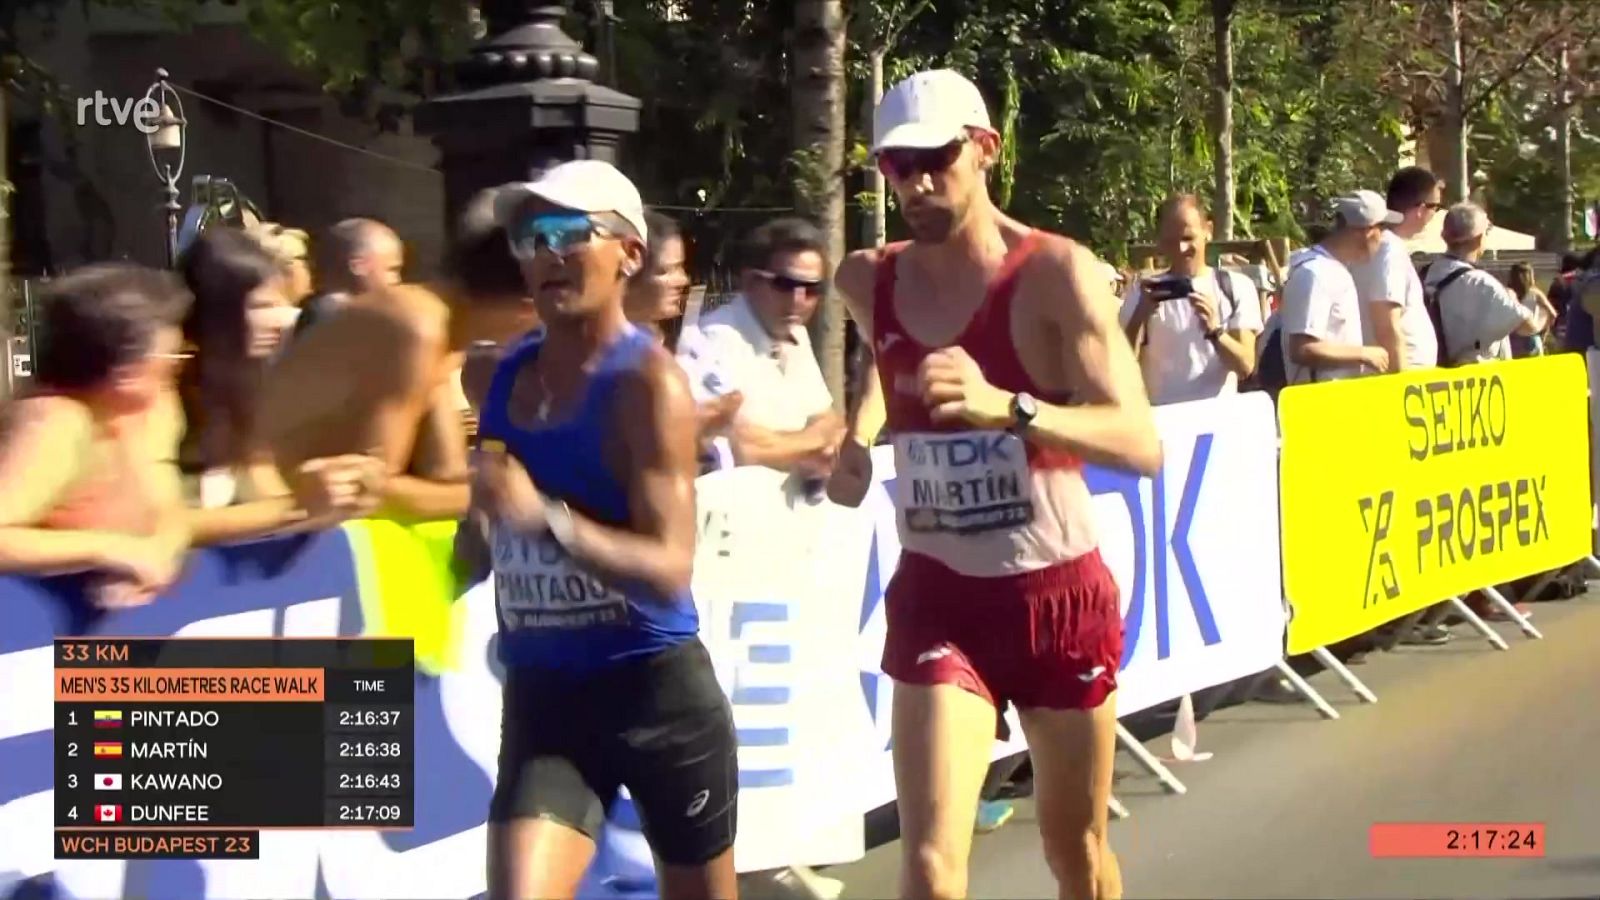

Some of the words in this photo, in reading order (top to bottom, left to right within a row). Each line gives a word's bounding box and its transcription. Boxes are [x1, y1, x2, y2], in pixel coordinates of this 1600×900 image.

[924, 435, 1010, 466] TDK
[1404, 375, 1506, 461] SEIKO
[1416, 475, 1549, 574] PROSPEX
